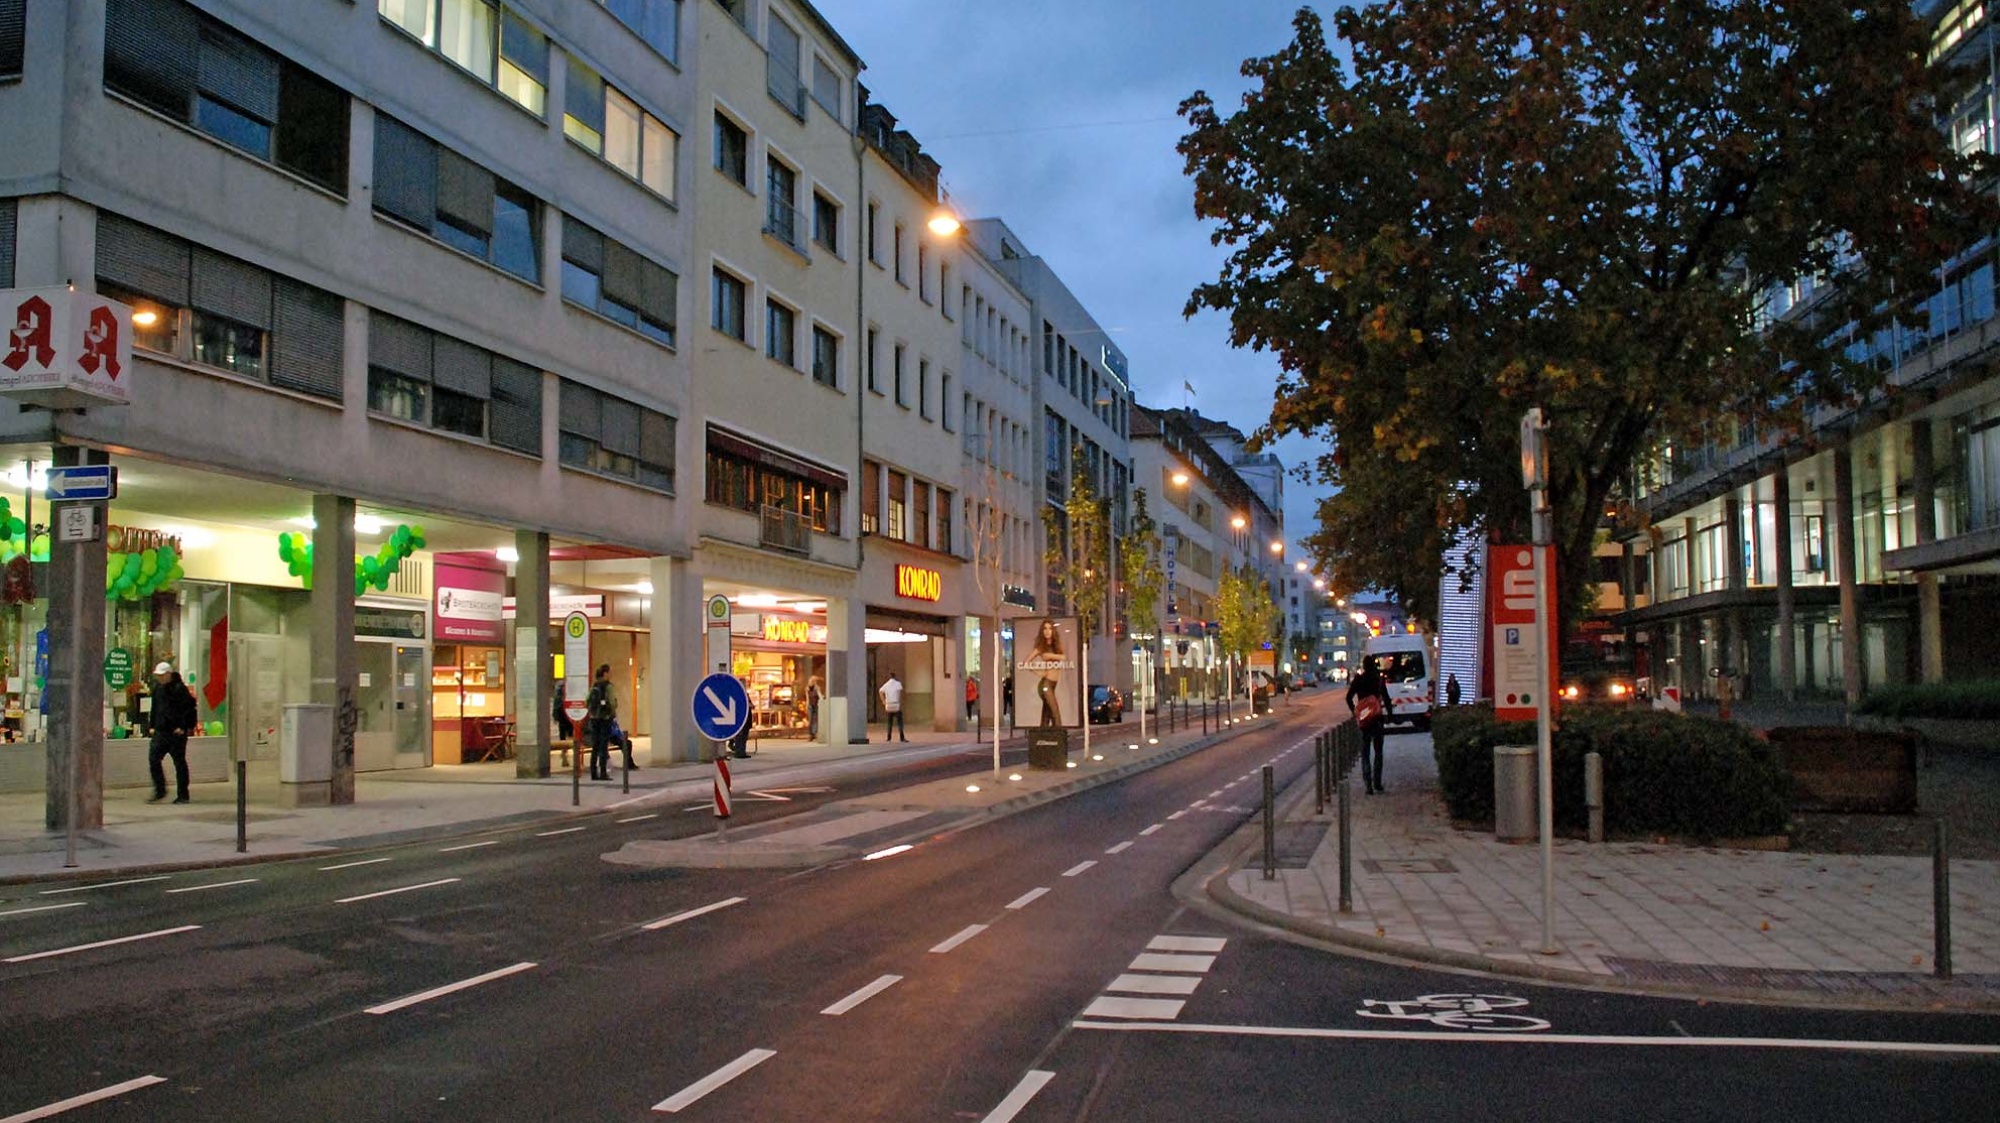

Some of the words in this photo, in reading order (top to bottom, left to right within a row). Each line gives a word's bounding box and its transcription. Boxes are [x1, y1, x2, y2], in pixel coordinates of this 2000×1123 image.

[899, 564, 941, 602] KONRAD
[1167, 547, 1175, 603] HOTEL
[764, 616, 809, 643] KONRAD
[1017, 661, 1075, 670] CALZEDONIA
